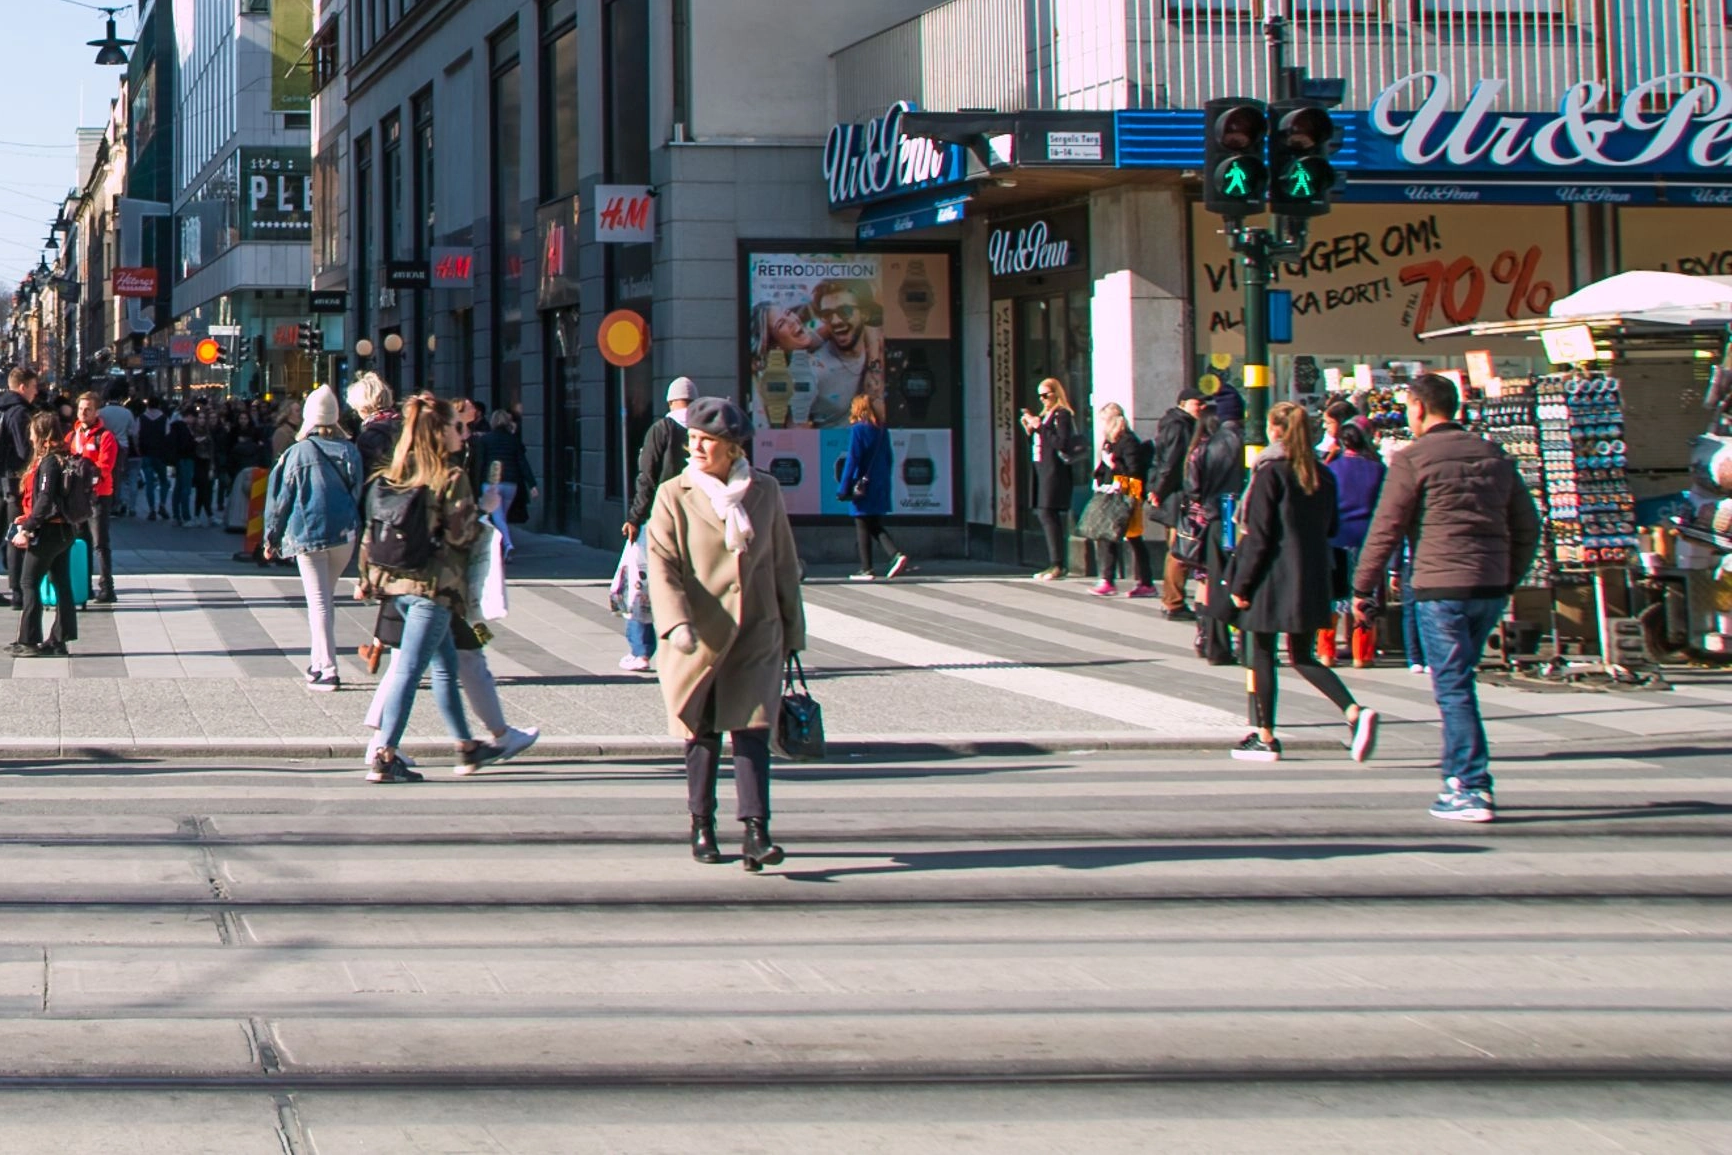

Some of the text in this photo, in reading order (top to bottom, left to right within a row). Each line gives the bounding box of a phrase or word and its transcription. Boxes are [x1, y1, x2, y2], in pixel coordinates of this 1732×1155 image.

[599, 196, 652, 231] H&M
[435, 254, 473, 279] H&M
[988, 220, 1069, 276] Ur&Penn
[1203, 258, 1238, 293] VI
[1380, 215, 1443, 257] OM!
[757, 264, 875, 277] RETRODDICTION
[1291, 291, 1322, 316] KA
[1324, 277, 1392, 310] BORT!
